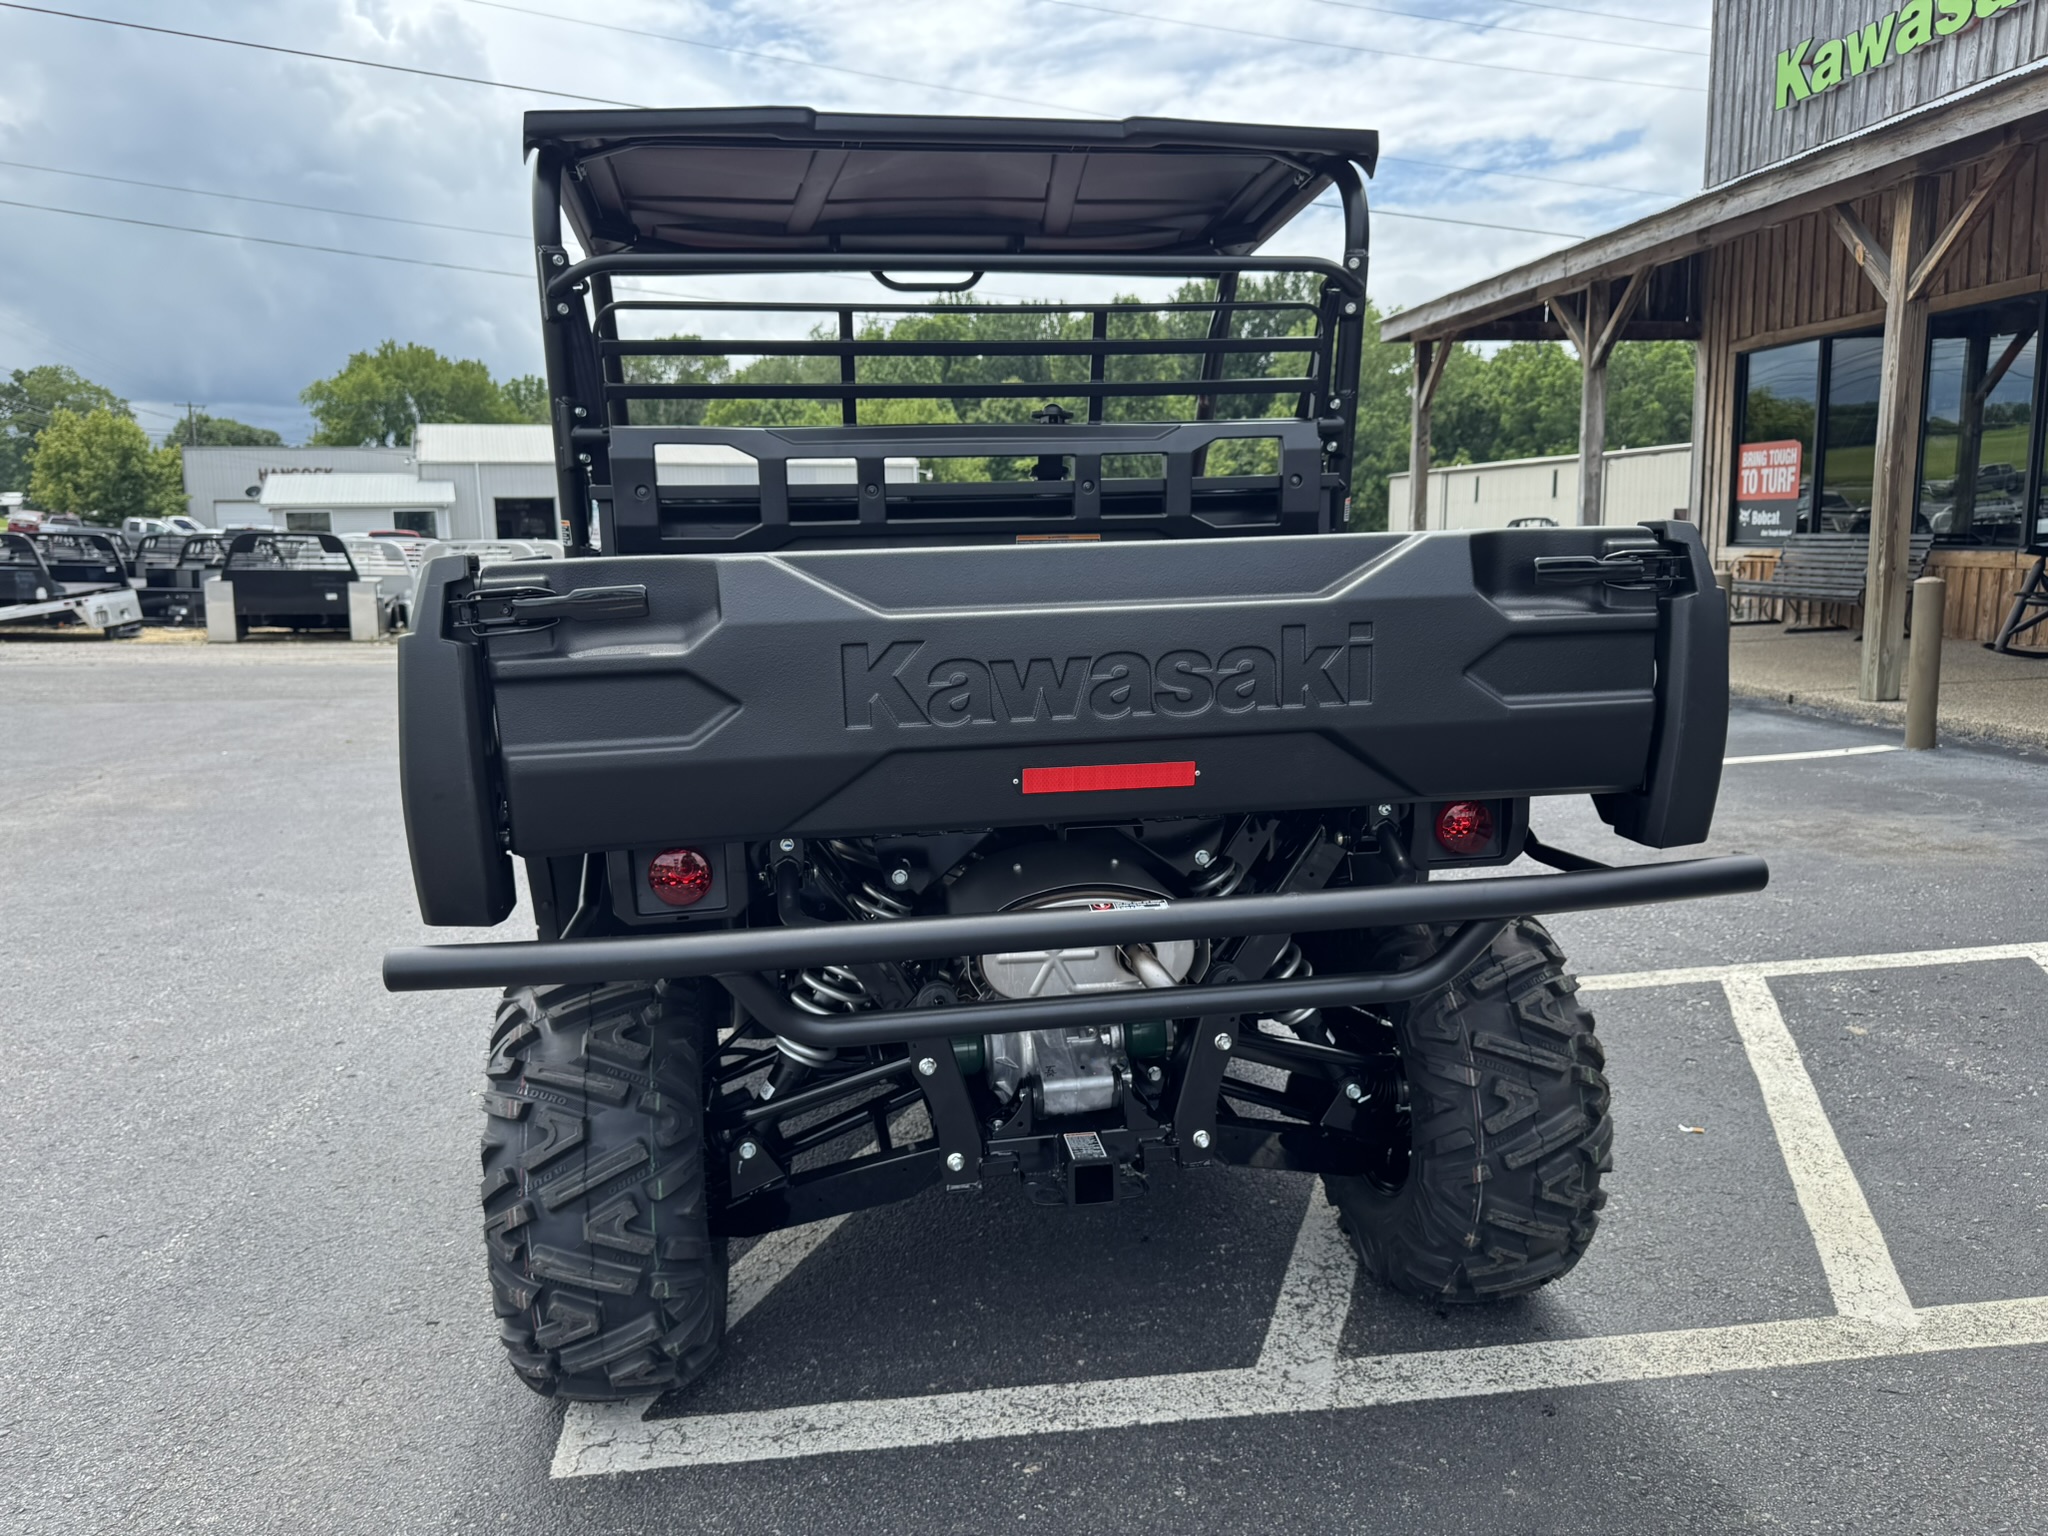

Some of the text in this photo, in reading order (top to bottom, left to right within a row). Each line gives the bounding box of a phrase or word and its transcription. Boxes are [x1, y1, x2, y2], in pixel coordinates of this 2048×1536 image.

[1742, 448, 1797, 468] BRING TOUGH
[1741, 466, 1796, 494] TO TURF
[1751, 510, 1780, 526] Bobcat
[841, 621, 1374, 730] Kawasaki
